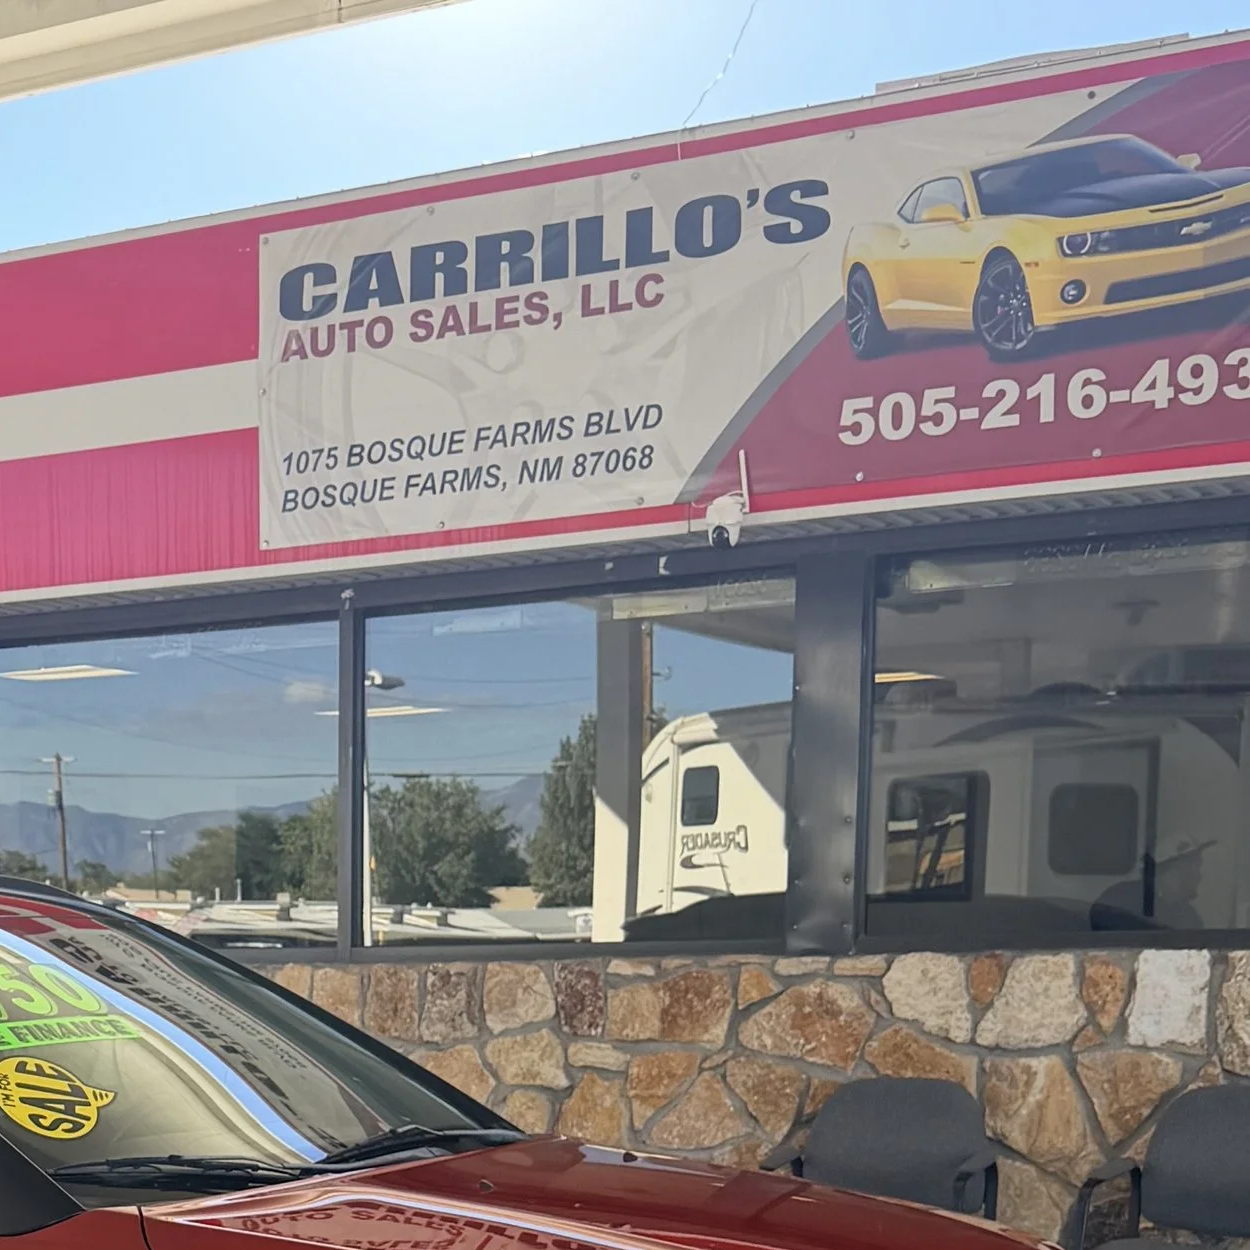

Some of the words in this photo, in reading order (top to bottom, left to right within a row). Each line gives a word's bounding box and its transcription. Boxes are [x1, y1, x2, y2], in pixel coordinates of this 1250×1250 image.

[279, 179, 831, 322] CARRILLO'S
[280, 315, 394, 363] AUTO
[408, 290, 563, 331] SALES,
[580, 273, 665, 318] LLC
[282, 446, 339, 476] 1075
[346, 430, 466, 468] BOSQUE
[473, 416, 575, 453] FARMS
[583, 403, 663, 438] BLVD
[281, 477, 396, 513] BOSQUE
[404, 464, 507, 499] FARMS,
[518, 456, 563, 485] NM
[572, 445, 655, 479] 87068
[7, 1019, 136, 1044] FINANCE
[15, 1060, 92, 1133] SALE
